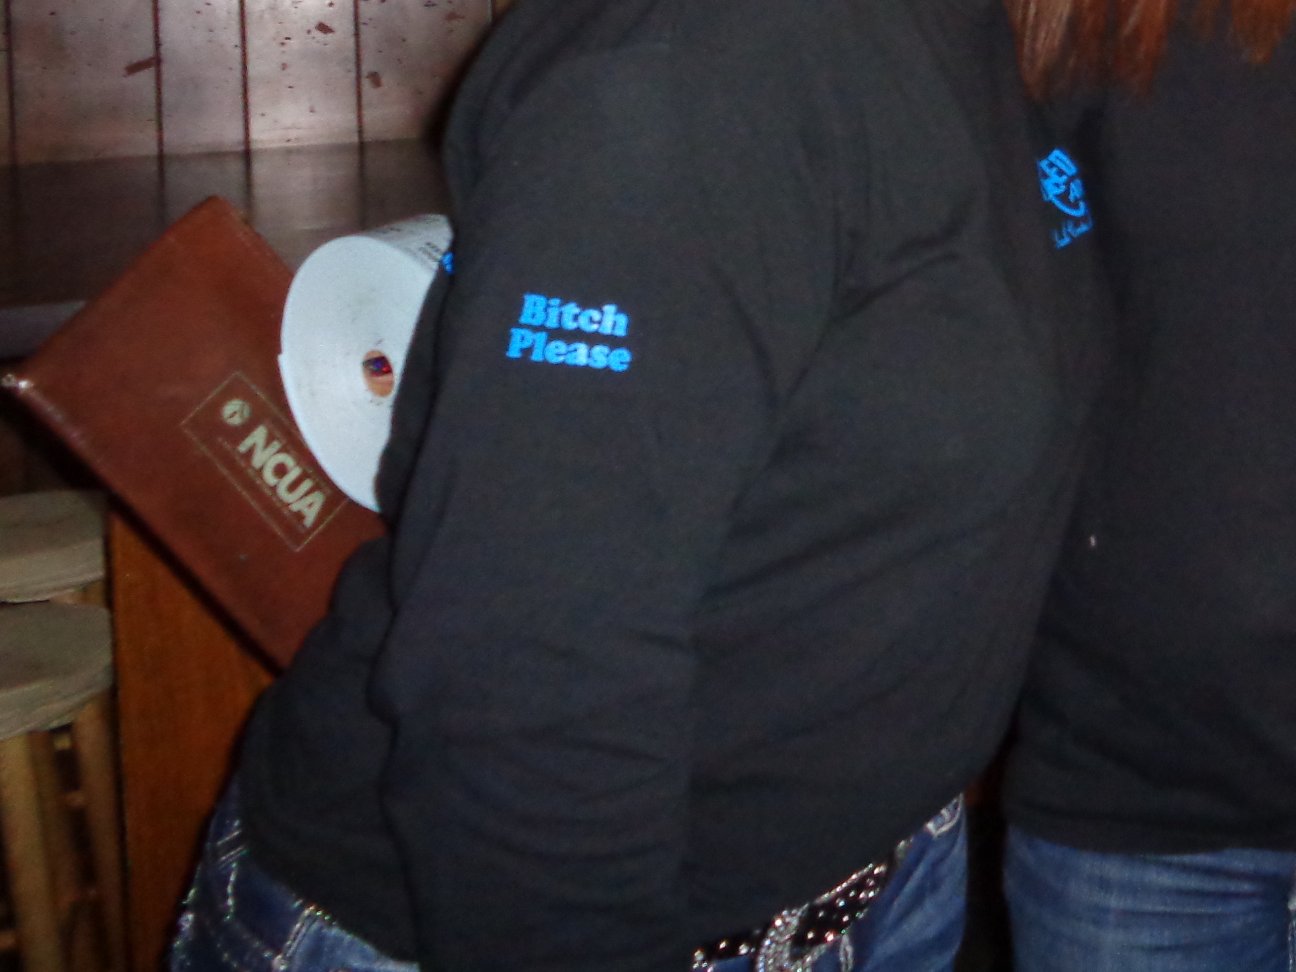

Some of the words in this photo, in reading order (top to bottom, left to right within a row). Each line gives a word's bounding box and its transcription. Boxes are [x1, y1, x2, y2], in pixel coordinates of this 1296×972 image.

[519, 292, 630, 337] Bitch
[506, 327, 632, 372] Please
[237, 425, 326, 528] NCUA
